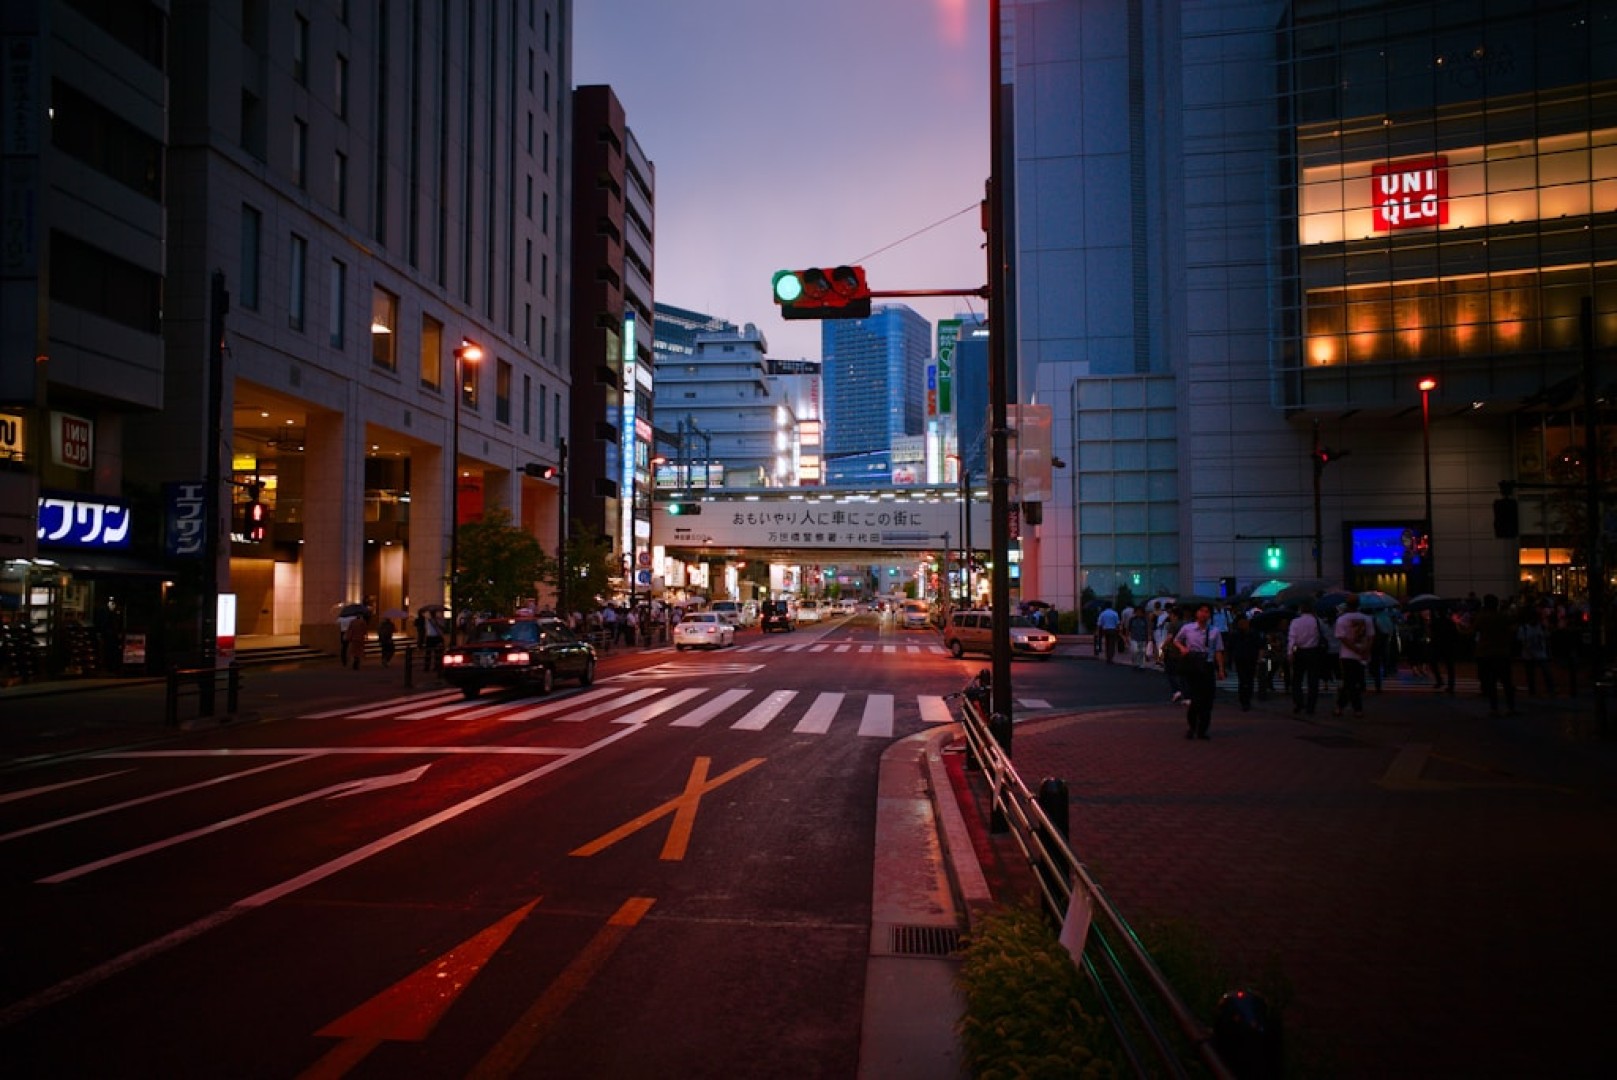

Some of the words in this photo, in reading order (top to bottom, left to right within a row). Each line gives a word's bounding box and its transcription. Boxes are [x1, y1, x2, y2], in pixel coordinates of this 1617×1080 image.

[1380, 169, 1437, 195] UNI
[1381, 193, 1437, 225] QLO
[176, 484, 203, 555] エフワン
